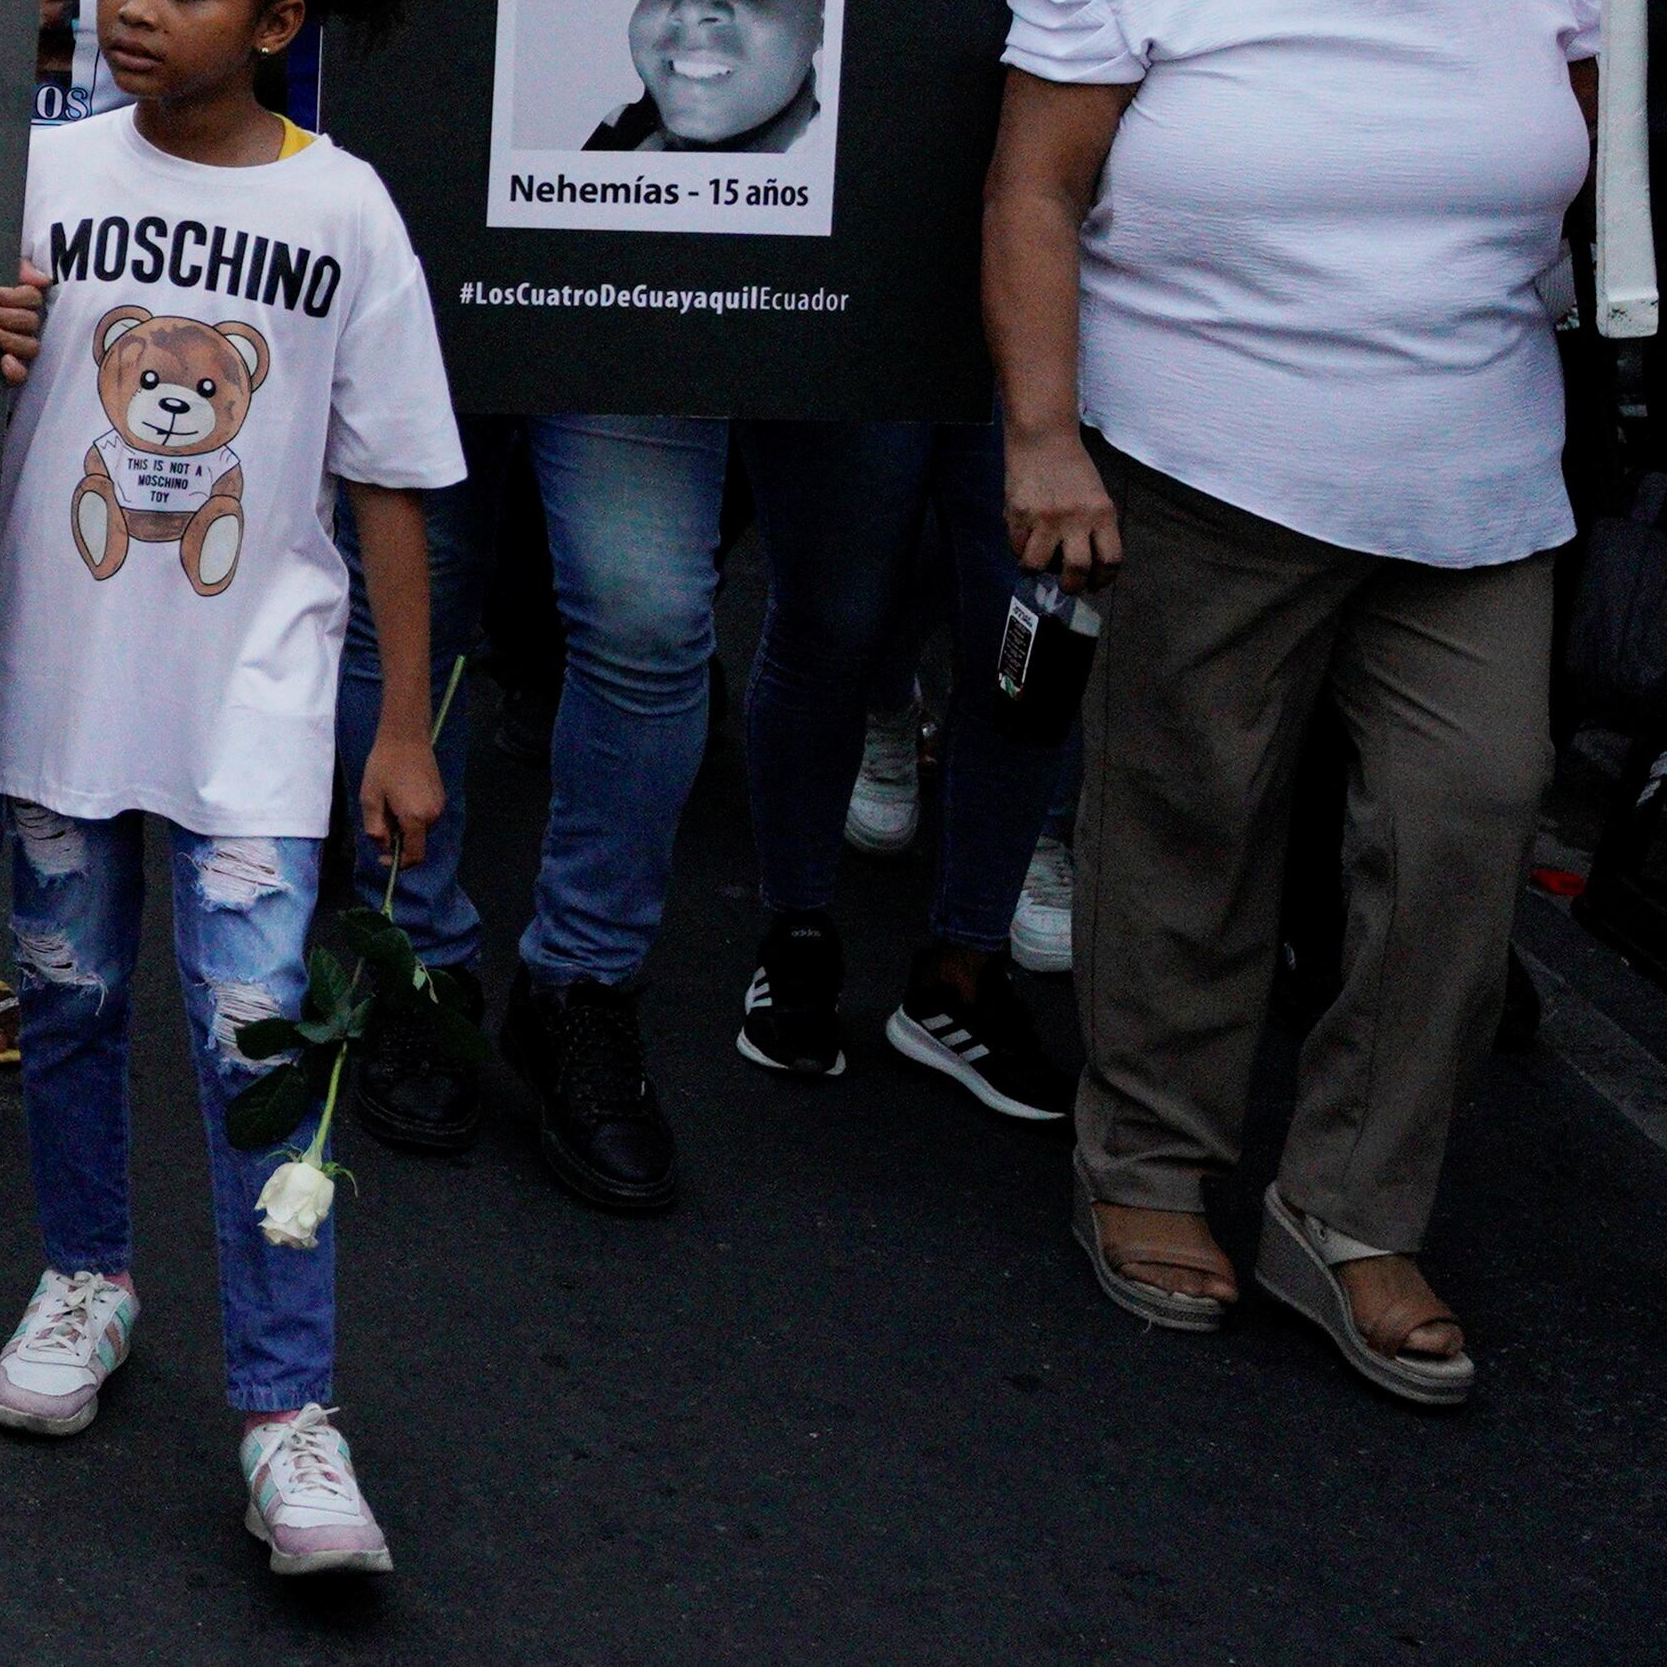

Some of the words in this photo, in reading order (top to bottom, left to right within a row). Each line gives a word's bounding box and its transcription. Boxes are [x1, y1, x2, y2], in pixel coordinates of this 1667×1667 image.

[36, 84, 89, 120] OS
[511, 174, 679, 204] Nehemías
[710, 179, 738, 205] 15
[746, 179, 808, 206] años
[50, 215, 342, 318] MOSCHINO
[460, 282, 848, 314] #LosCuatroDeGuayaquilEcuador
[128, 458, 148, 470] THIS
[153, 459, 164, 471] IS
[169, 462, 190, 474] NOT
[195, 465, 203, 476] A
[138, 474, 189, 490] MOSCHINO
[150, 490, 170, 503] TOY
